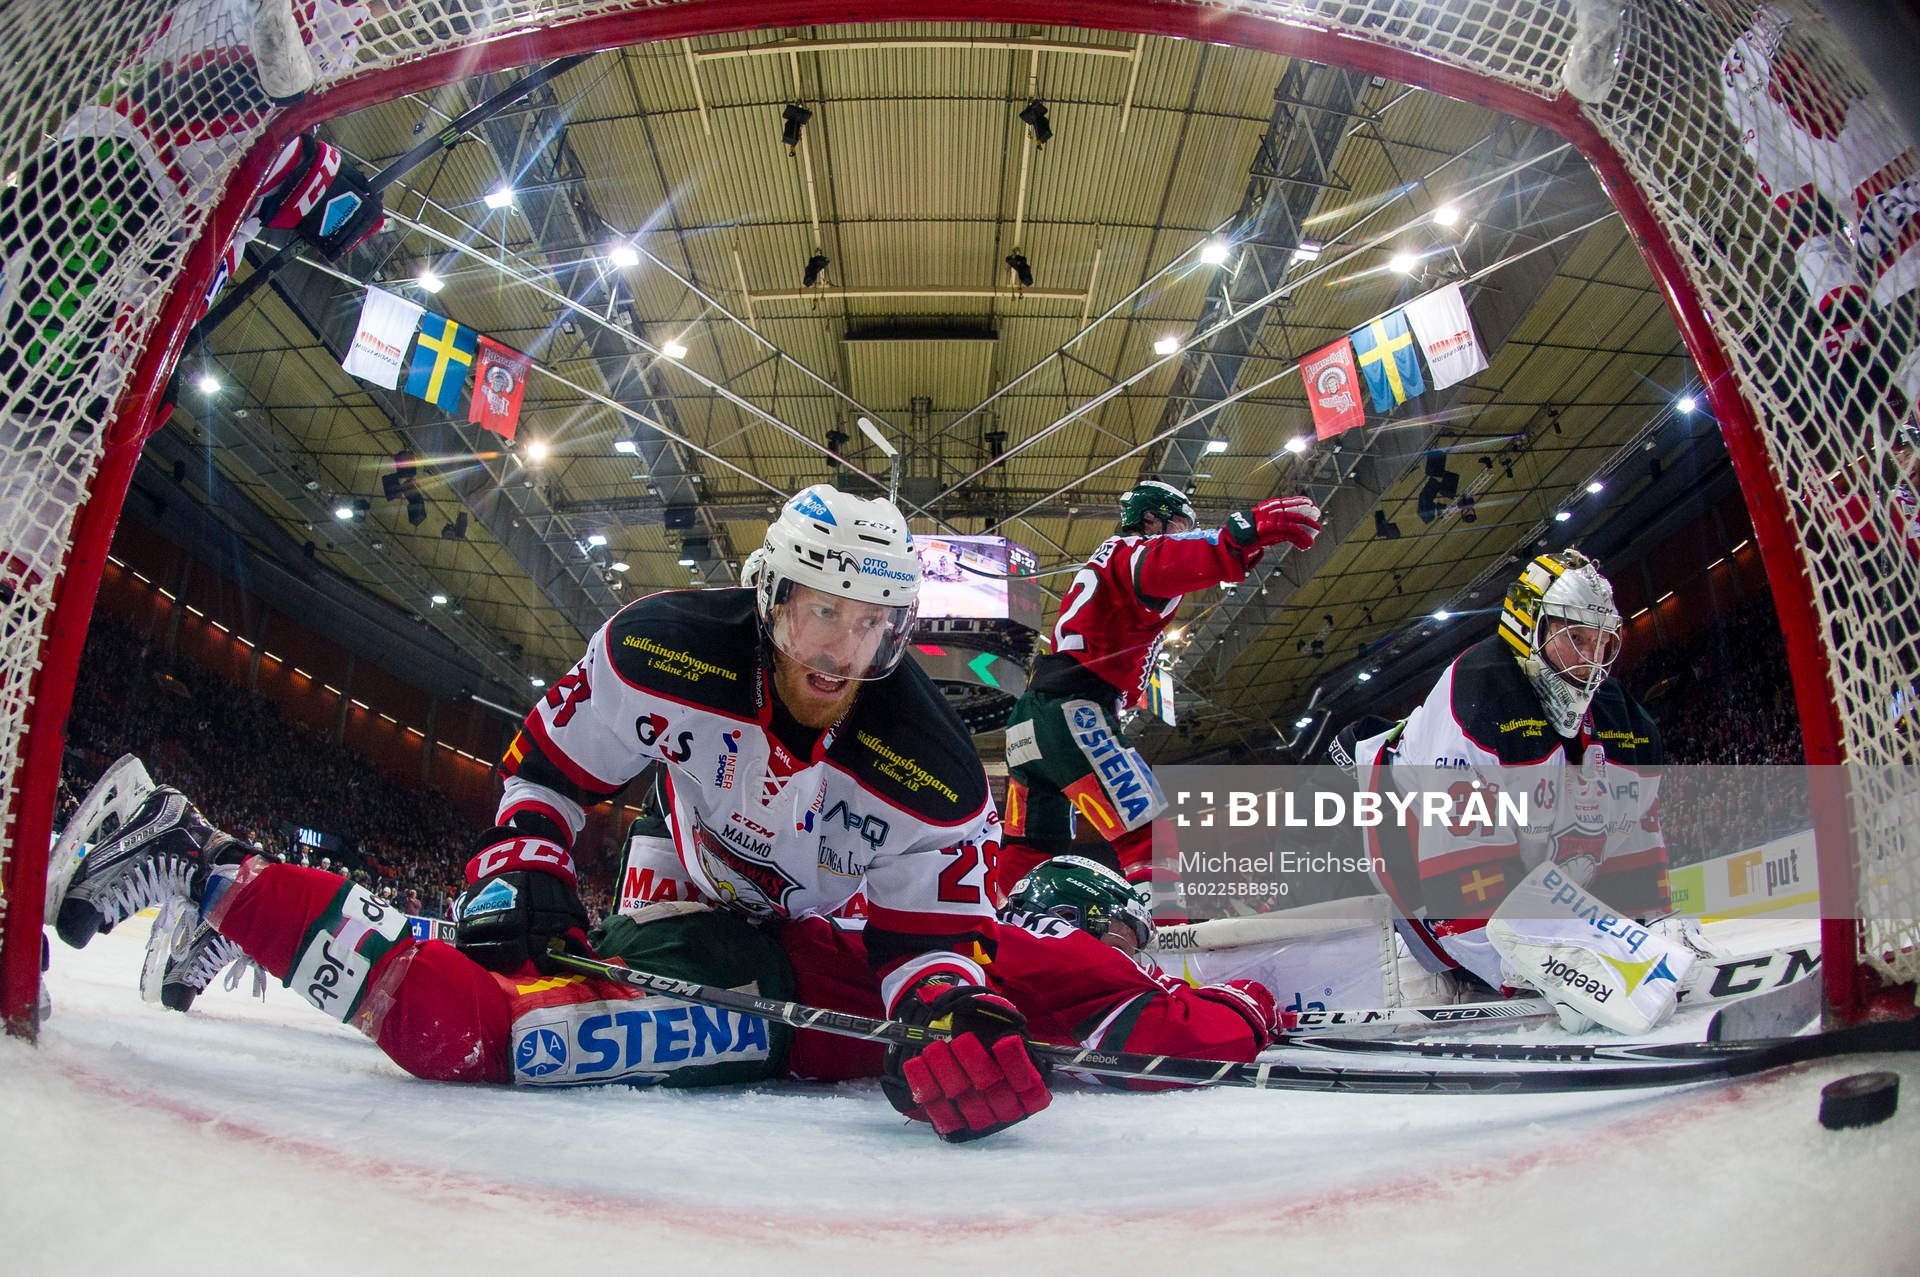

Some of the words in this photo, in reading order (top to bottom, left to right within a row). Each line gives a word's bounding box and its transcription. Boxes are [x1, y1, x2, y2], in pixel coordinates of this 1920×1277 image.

[861, 565, 916, 582] MAGNUSSON
[863, 557, 889, 569] OTTO
[1587, 603, 1614, 615] CCM
[622, 634, 738, 682] Ställningsbyggarna
[647, 657, 653, 667] i
[653, 660, 683, 677] Skåne
[683, 670, 701, 682] AB
[635, 712, 694, 765] G4S
[714, 754, 728, 789] SPORT
[721, 753, 737, 791] INTER
[773, 745, 793, 769] SHL
[856, 729, 959, 804] Ställningsbyggarna
[902, 778, 921, 792] AB
[1079, 727, 1151, 823] STENA
[721, 823, 773, 858] MALMÖ
[1065, 877, 1101, 896] EASTON
[1542, 868, 1649, 955] bravida
[1157, 927, 1200, 950] eebok
[626, 969, 703, 998] CCM
[1540, 954, 1614, 1005] Reebok
[574, 1005, 769, 1075] STENA
